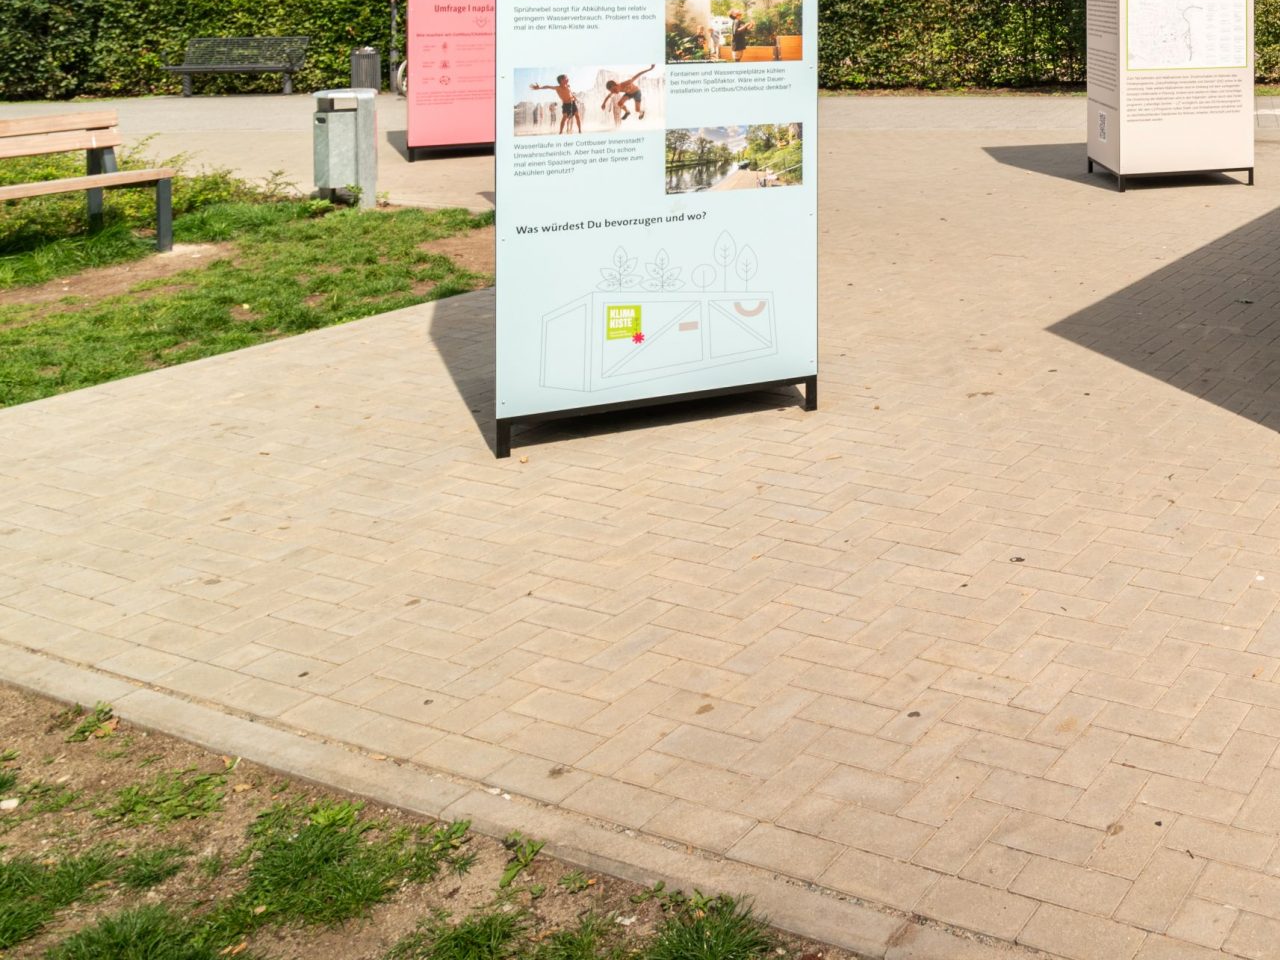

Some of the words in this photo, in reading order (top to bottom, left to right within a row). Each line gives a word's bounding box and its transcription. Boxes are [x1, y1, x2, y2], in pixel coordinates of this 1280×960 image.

[434, 4, 466, 13] Umfrage
[516, 225, 539, 235] Was
[541, 222, 585, 232] würdest
[587, 220, 602, 229] Du
[604, 216, 663, 228] bevorzugen
[665, 213, 684, 223] und
[687, 211, 707, 220] wo?
[610, 309, 635, 318] KLIMA
[610, 318, 632, 329] KISTE
